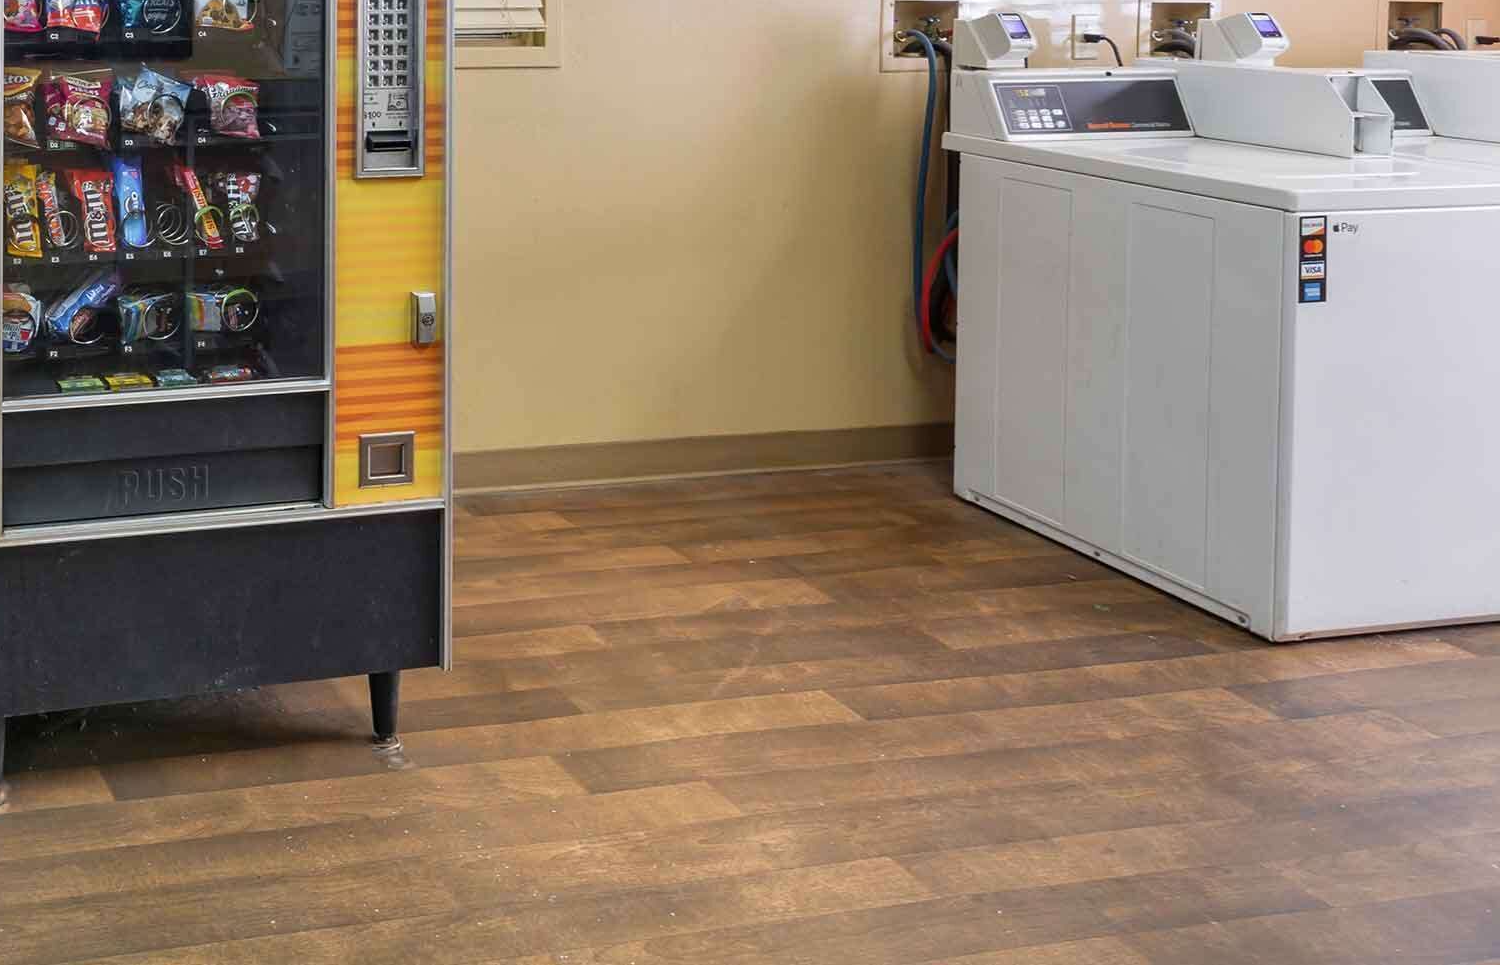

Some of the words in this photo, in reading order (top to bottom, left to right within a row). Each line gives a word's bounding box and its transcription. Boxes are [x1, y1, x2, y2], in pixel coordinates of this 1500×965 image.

[1341, 222, 1358, 234] Pay
[1304, 266, 1322, 274] VISA
[122, 463, 209, 506] PUSH
